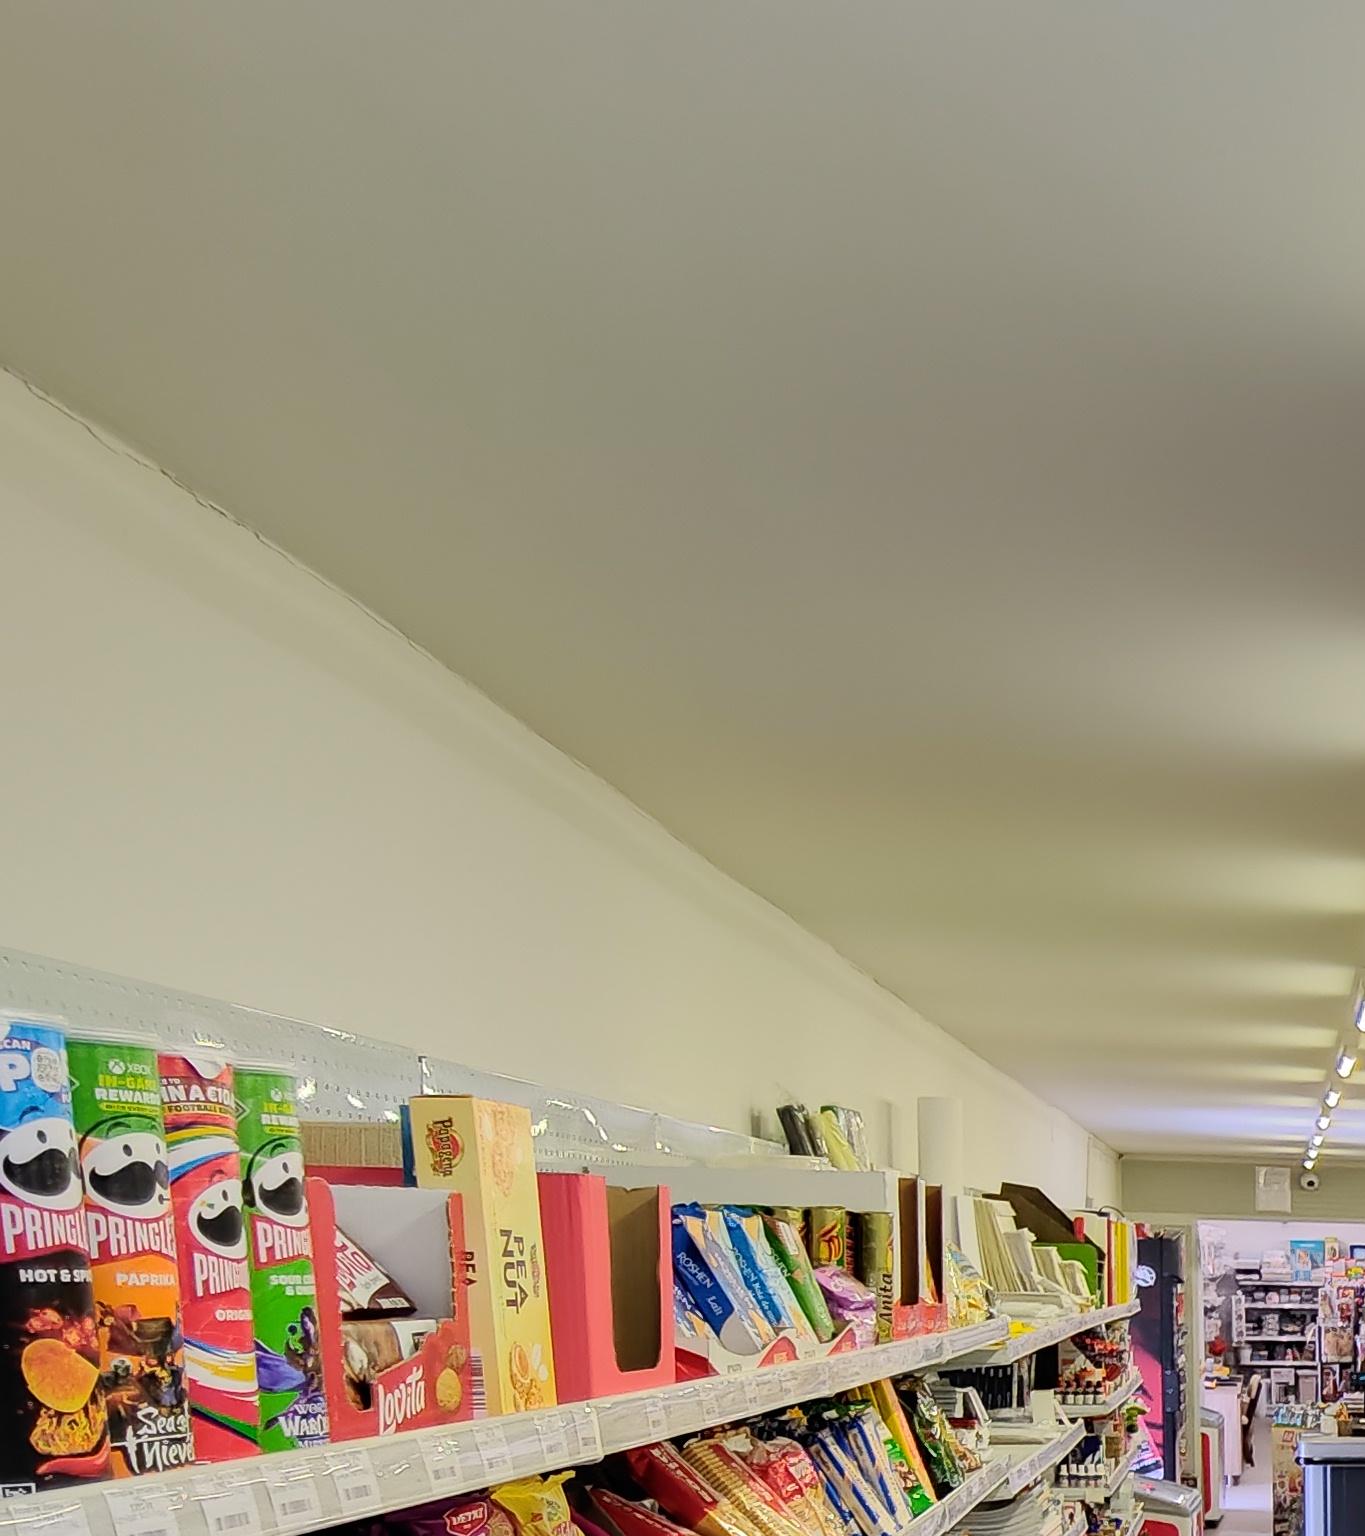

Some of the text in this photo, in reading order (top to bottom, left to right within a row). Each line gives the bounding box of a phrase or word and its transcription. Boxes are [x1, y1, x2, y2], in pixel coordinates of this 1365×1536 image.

[20, 1269, 71, 1283] HOT &
[499, 1229, 521, 1314] NUT
[512, 1234, 529, 1307] PEA
[676, 1251, 715, 1289] ROSHEN
[878, 1272, 894, 1325] Anita
